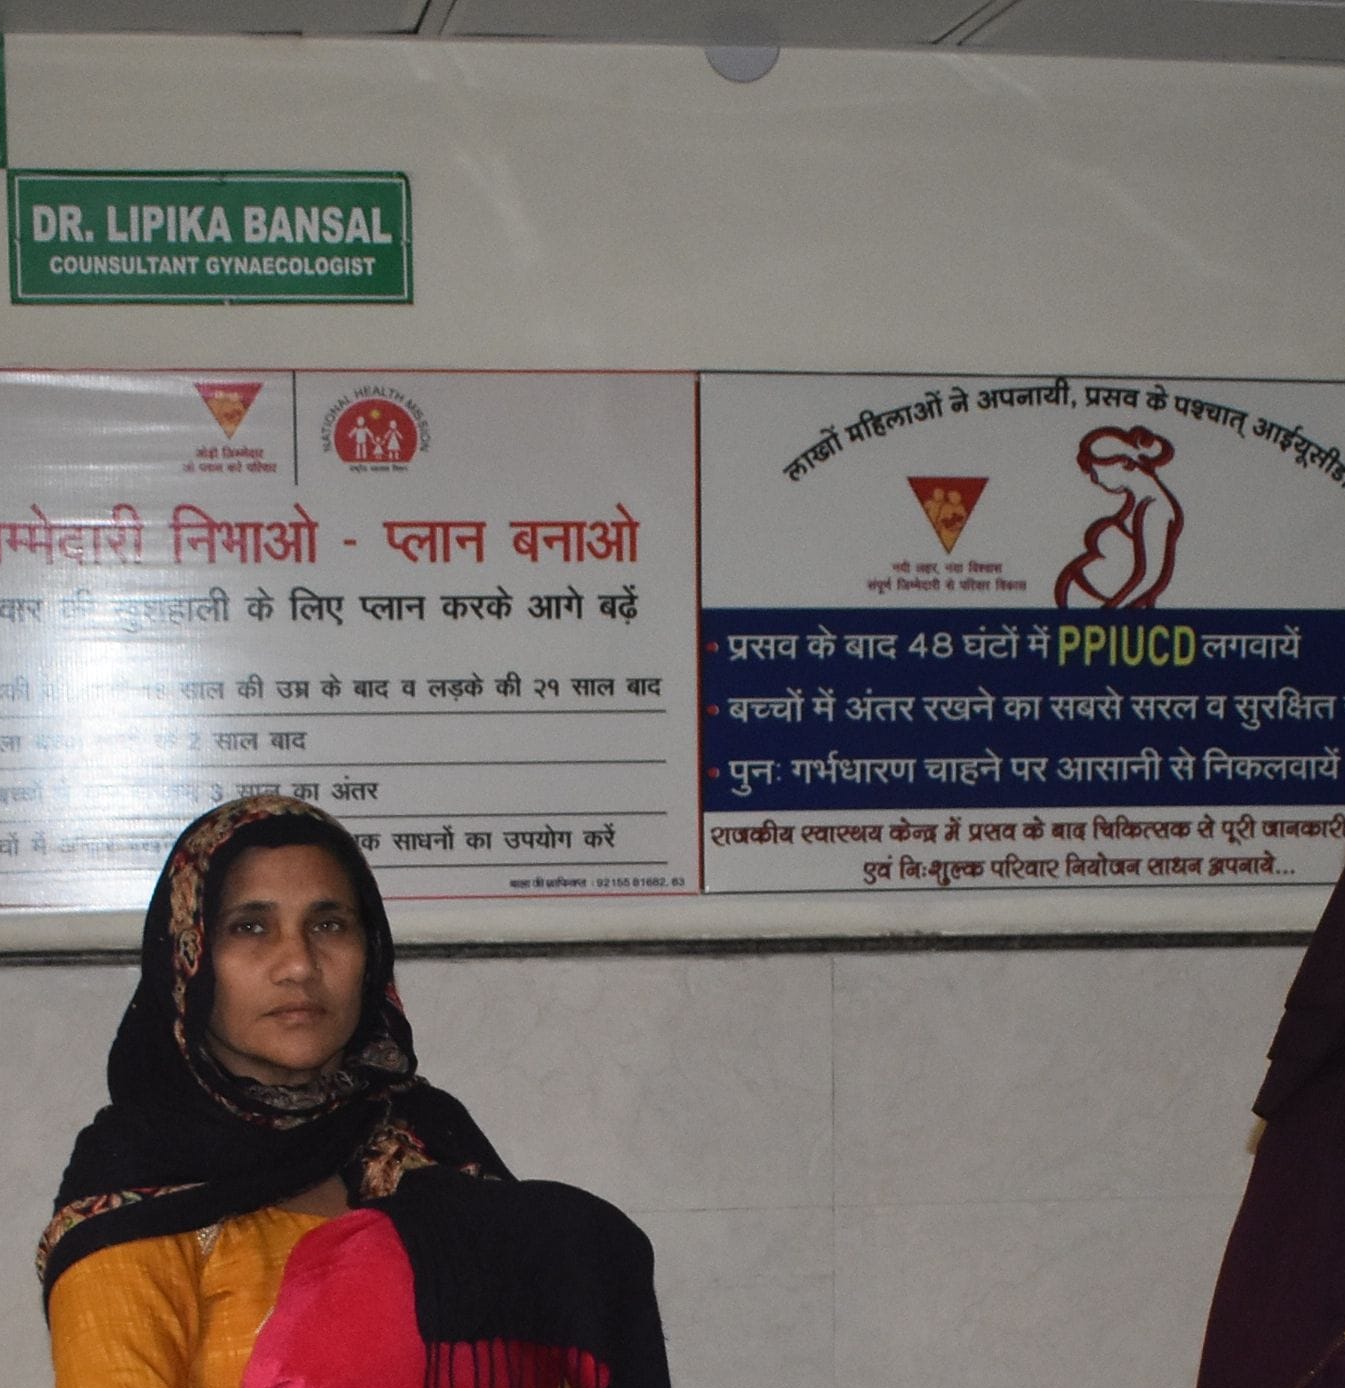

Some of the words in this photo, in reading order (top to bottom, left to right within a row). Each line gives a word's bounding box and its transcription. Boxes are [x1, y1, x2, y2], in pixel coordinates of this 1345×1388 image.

[32, 205, 94, 243] DR.
[107, 205, 233, 244] LIPIKA
[243, 206, 393, 244] BANSAL
[49, 256, 201, 276] COUNSULTANT
[205, 257, 377, 277] GYNAECOLOGIST
[782, 424, 844, 482] लाखों
[844, 388, 944, 443] महिलाओं
[948, 386, 969, 414] ने
[1085, 386, 1140, 408] प्रसव
[1146, 384, 1169, 412] के
[170, 503, 319, 564] निभाओ
[383, 521, 486, 563] प्लान
[509, 502, 640, 563] बनाओ
[245, 587, 278, 621] के
[290, 587, 344, 626] लिए
[358, 596, 426, 620] प्लान
[440, 585, 513, 620] करके
[528, 585, 583, 620] आगे
[728, 634, 799, 661] प्रसव
[806, 624, 837, 660] के
[843, 634, 898, 661] बाद
[908, 632, 954, 659] 48
[962, 625, 1018, 660] घंटों
[1027, 625, 1051, 660] में
[1057, 624, 1198, 667] PPIUCD
[1201, 625, 1302, 660] लगवायें
[180, 680, 225, 701] साल
[237, 674, 264, 700] की
[276, 680, 310, 700] उम्र
[321, 674, 347, 698] के
[354, 679, 389, 699] बाद
[402, 679, 417, 698] व
[497, 672, 522, 698] की
[571, 677, 616, 698] साल
[628, 677, 663, 697] बाद
[728, 687, 805, 722] बच्चों
[811, 687, 837, 721] में
[845, 687, 916, 722] अंतर
[921, 686, 996, 721] रखने
[1002, 697, 1043, 721] का
[1049, 685, 1124, 721] सबसे
[1130, 696, 1199, 721] सरल
[1205, 696, 1227, 719] व
[1234, 686, 1337, 732] सुरक्षित
[212, 732, 259, 752] साल
[269, 731, 309, 751] बाद
[790, 750, 917, 784] गर्भधारण
[923, 747, 1003, 786] चाहने
[1010, 758, 1050, 783] पर
[1056, 746, 1162, 782] आसानी
[1168, 746, 1197, 781] से
[1203, 746, 1341, 781] निकलवायें
[294, 783, 320, 802] का
[331, 776, 379, 802] अंतर
[393, 824, 457, 850] साधनों
[466, 833, 494, 851] का
[503, 824, 573, 849] उपयोग
[583, 822, 616, 849] करें
[711, 819, 796, 846] राजकीय
[945, 815, 962, 842] में
[968, 822, 1017, 842] प्रसव
[1023, 815, 1046, 840] के
[1051, 822, 1088, 841] बाद
[1092, 814, 1192, 841] चिकित्सक
[1197, 813, 1216, 839] से
[1222, 813, 1257, 845] पूरी
[863, 855, 893, 885] एवं
[991, 852, 1060, 880] परिवार
[1065, 851, 1141, 878] नियोजन
[1147, 857, 1204, 877] साधन
